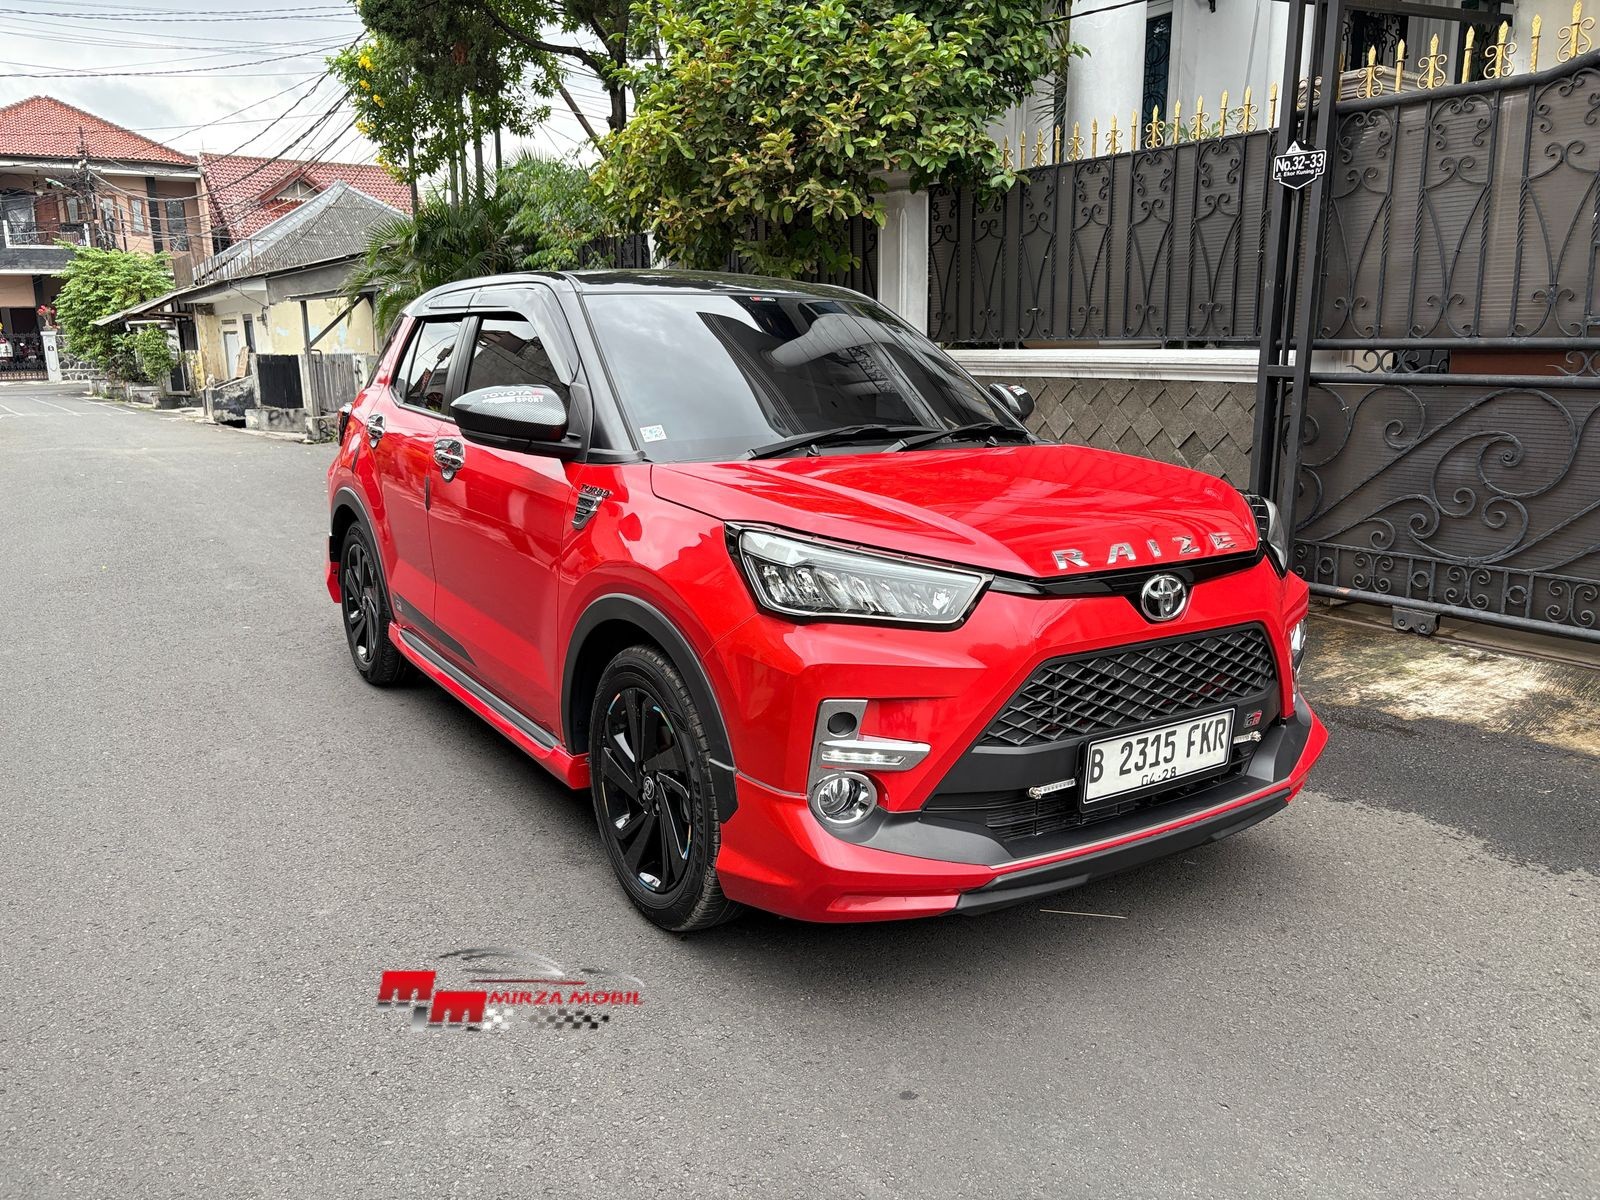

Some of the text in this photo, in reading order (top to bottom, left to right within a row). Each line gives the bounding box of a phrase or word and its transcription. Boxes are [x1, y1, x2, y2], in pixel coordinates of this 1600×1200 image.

[1275, 153, 1323, 172] No.32-33
[481, 390, 532, 399] TOYOTA
[515, 395, 544, 403] SPORT
[580, 483, 613, 499] TURBO
[1052, 532, 1237, 569] RAIZE
[1089, 718, 1227, 784] B 2315 FKR
